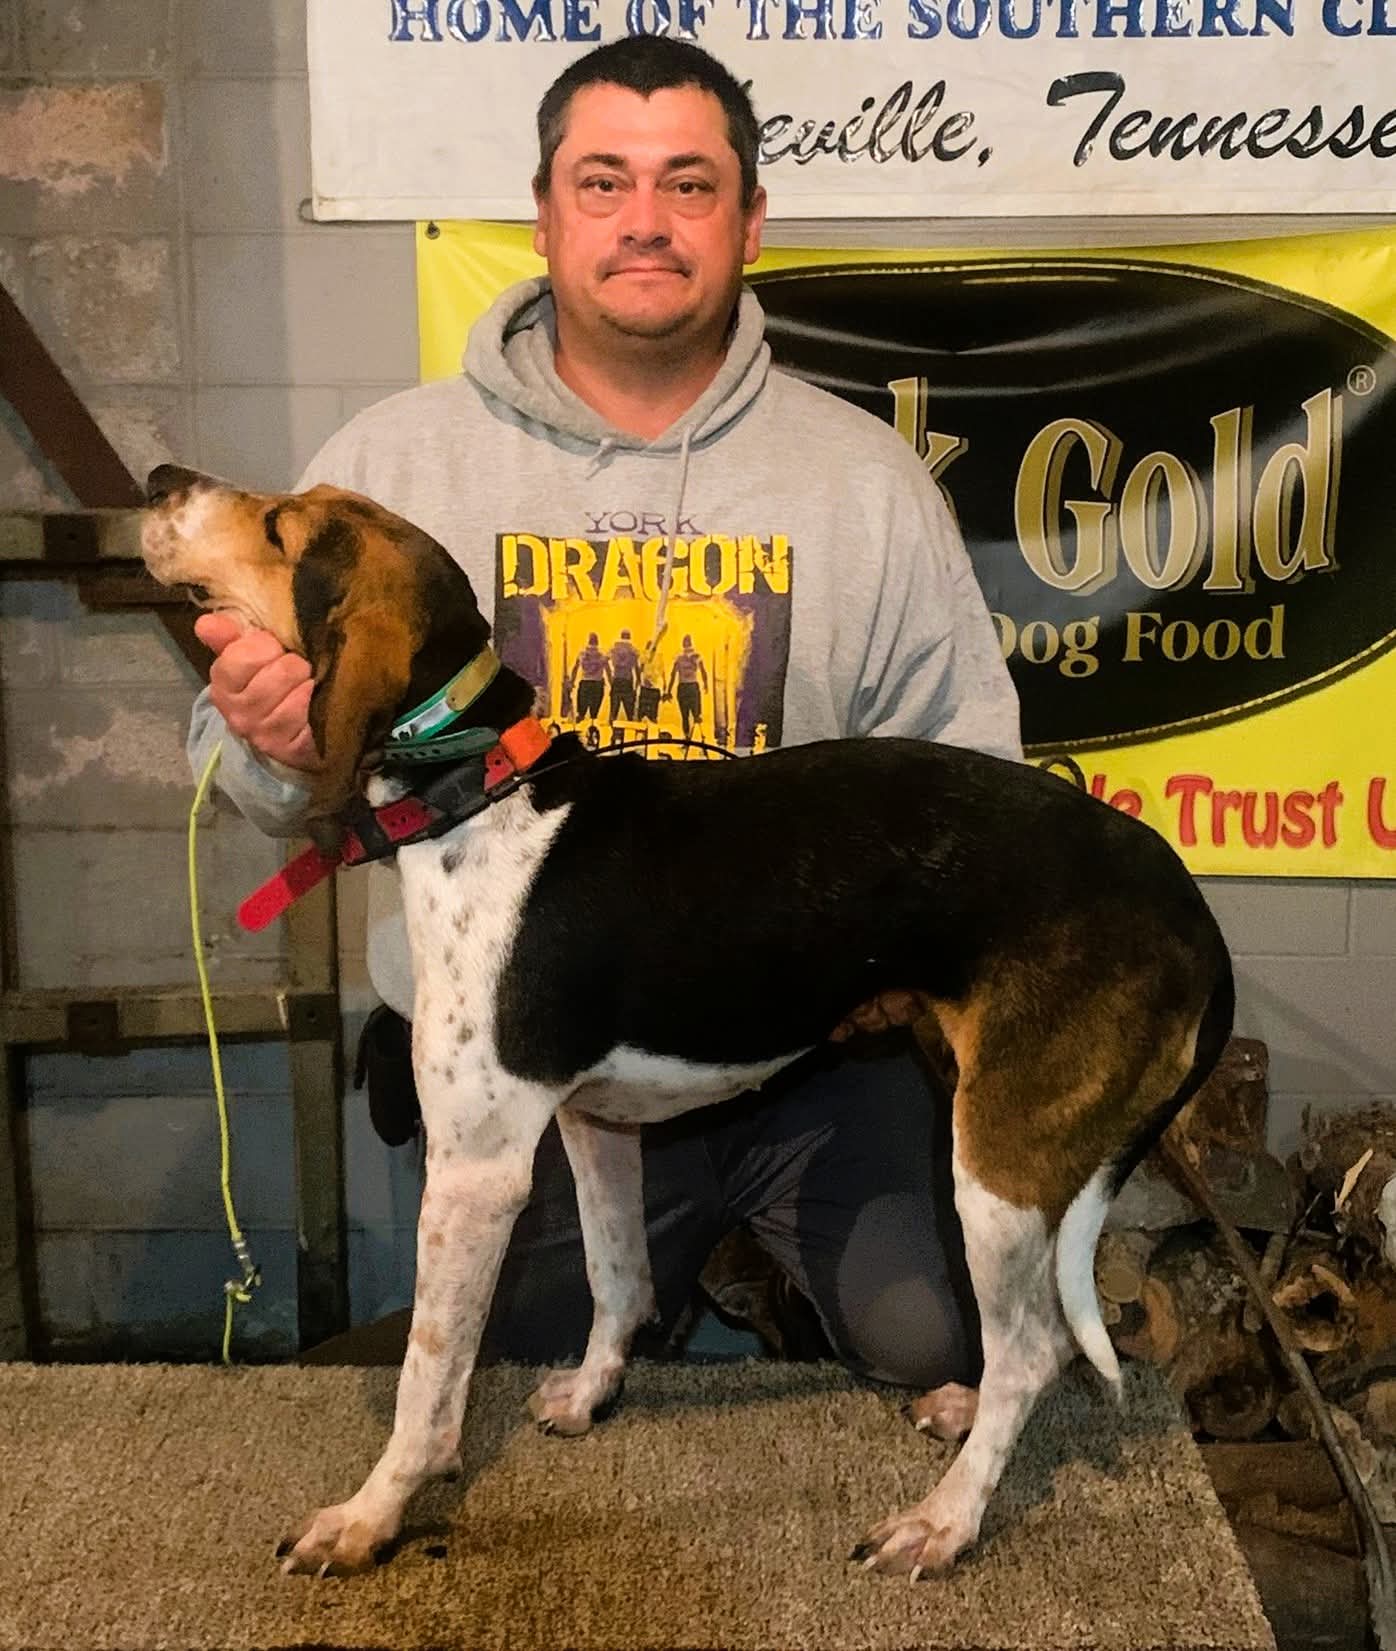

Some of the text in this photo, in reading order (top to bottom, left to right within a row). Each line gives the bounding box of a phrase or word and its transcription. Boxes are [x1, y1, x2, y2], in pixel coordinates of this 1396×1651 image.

[388, 0, 602, 42] HOME
[626, 0, 707, 40] OF
[736, 0, 883, 41] THE
[908, 0, 1295, 39] SOUTHERN
[740, 71, 1396, 167] eville, Tennesse
[584, 511, 705, 536] YORK
[1014, 388, 1343, 596] Gold
[501, 533, 790, 601] DRAGON
[1121, 604, 1286, 663] Food
[1165, 773, 1344, 849] Trust
